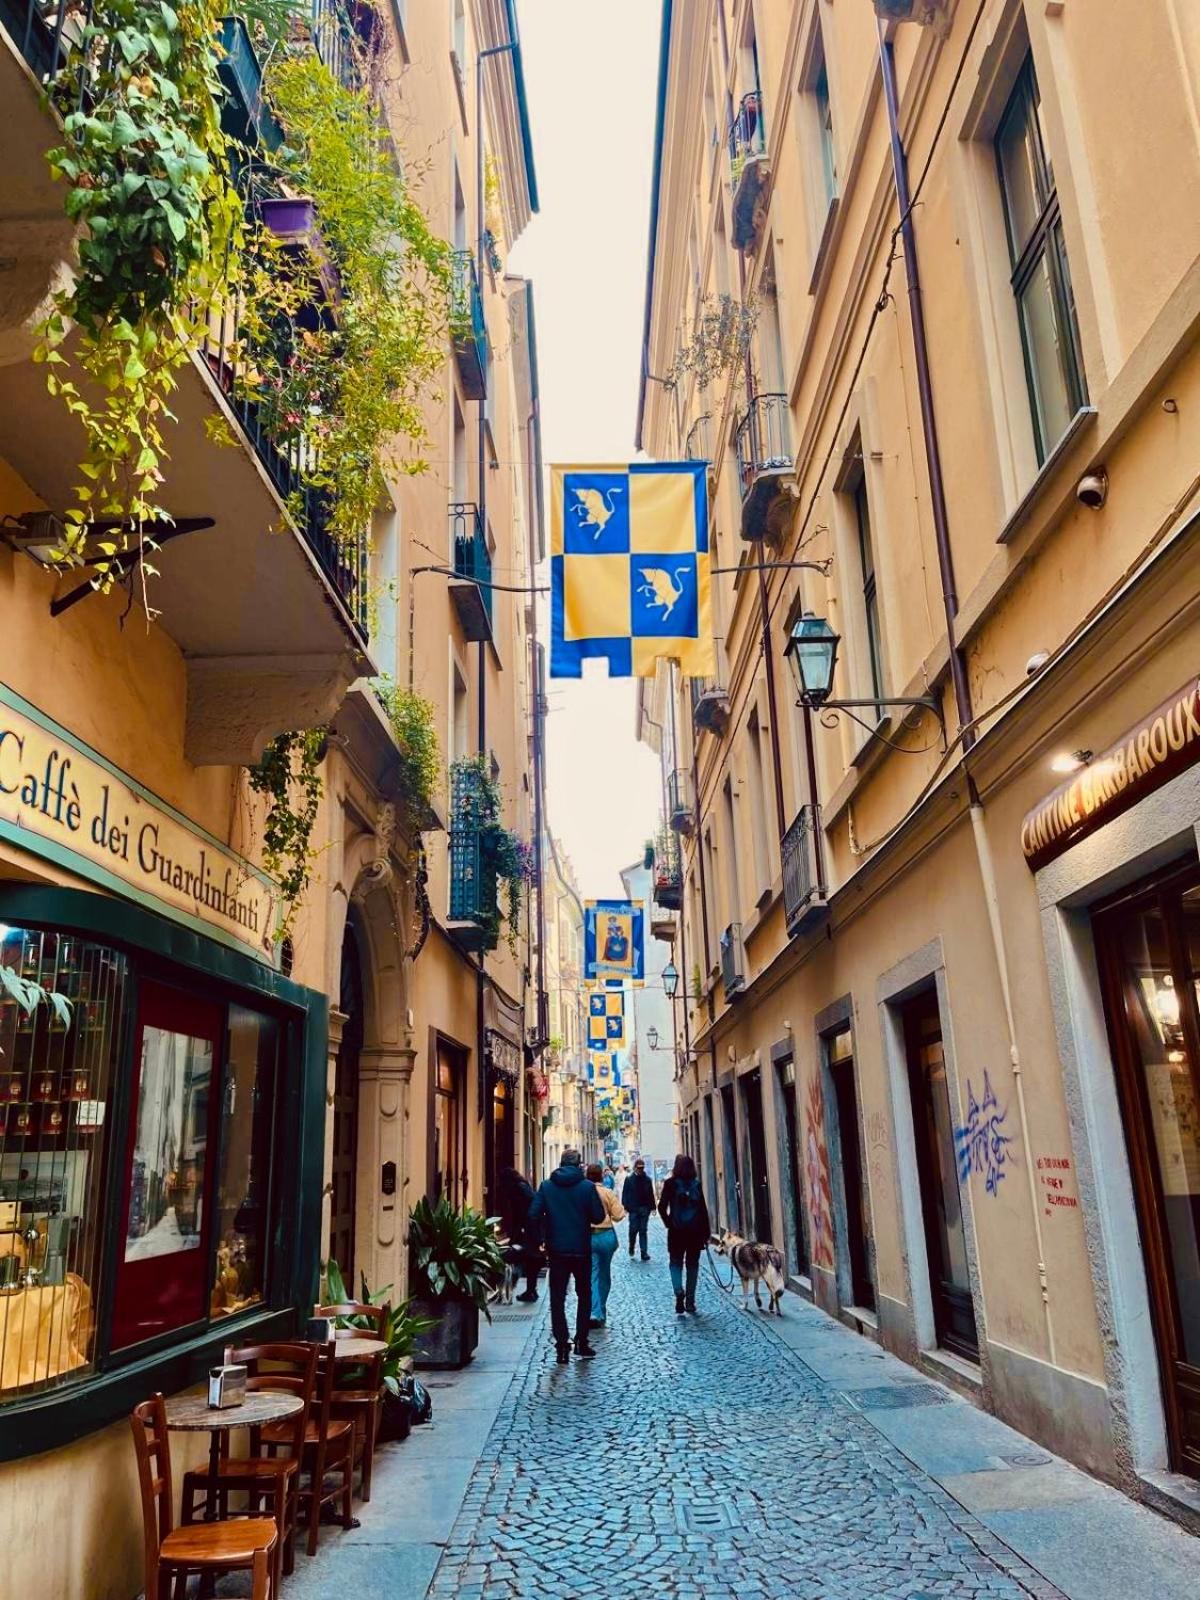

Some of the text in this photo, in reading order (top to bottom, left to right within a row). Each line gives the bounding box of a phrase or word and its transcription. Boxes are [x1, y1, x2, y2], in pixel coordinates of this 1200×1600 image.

[0, 730, 259, 933] Caffè dei Guardinfanti
[1021, 689, 1200, 857] CANTINE BARBAROUX
